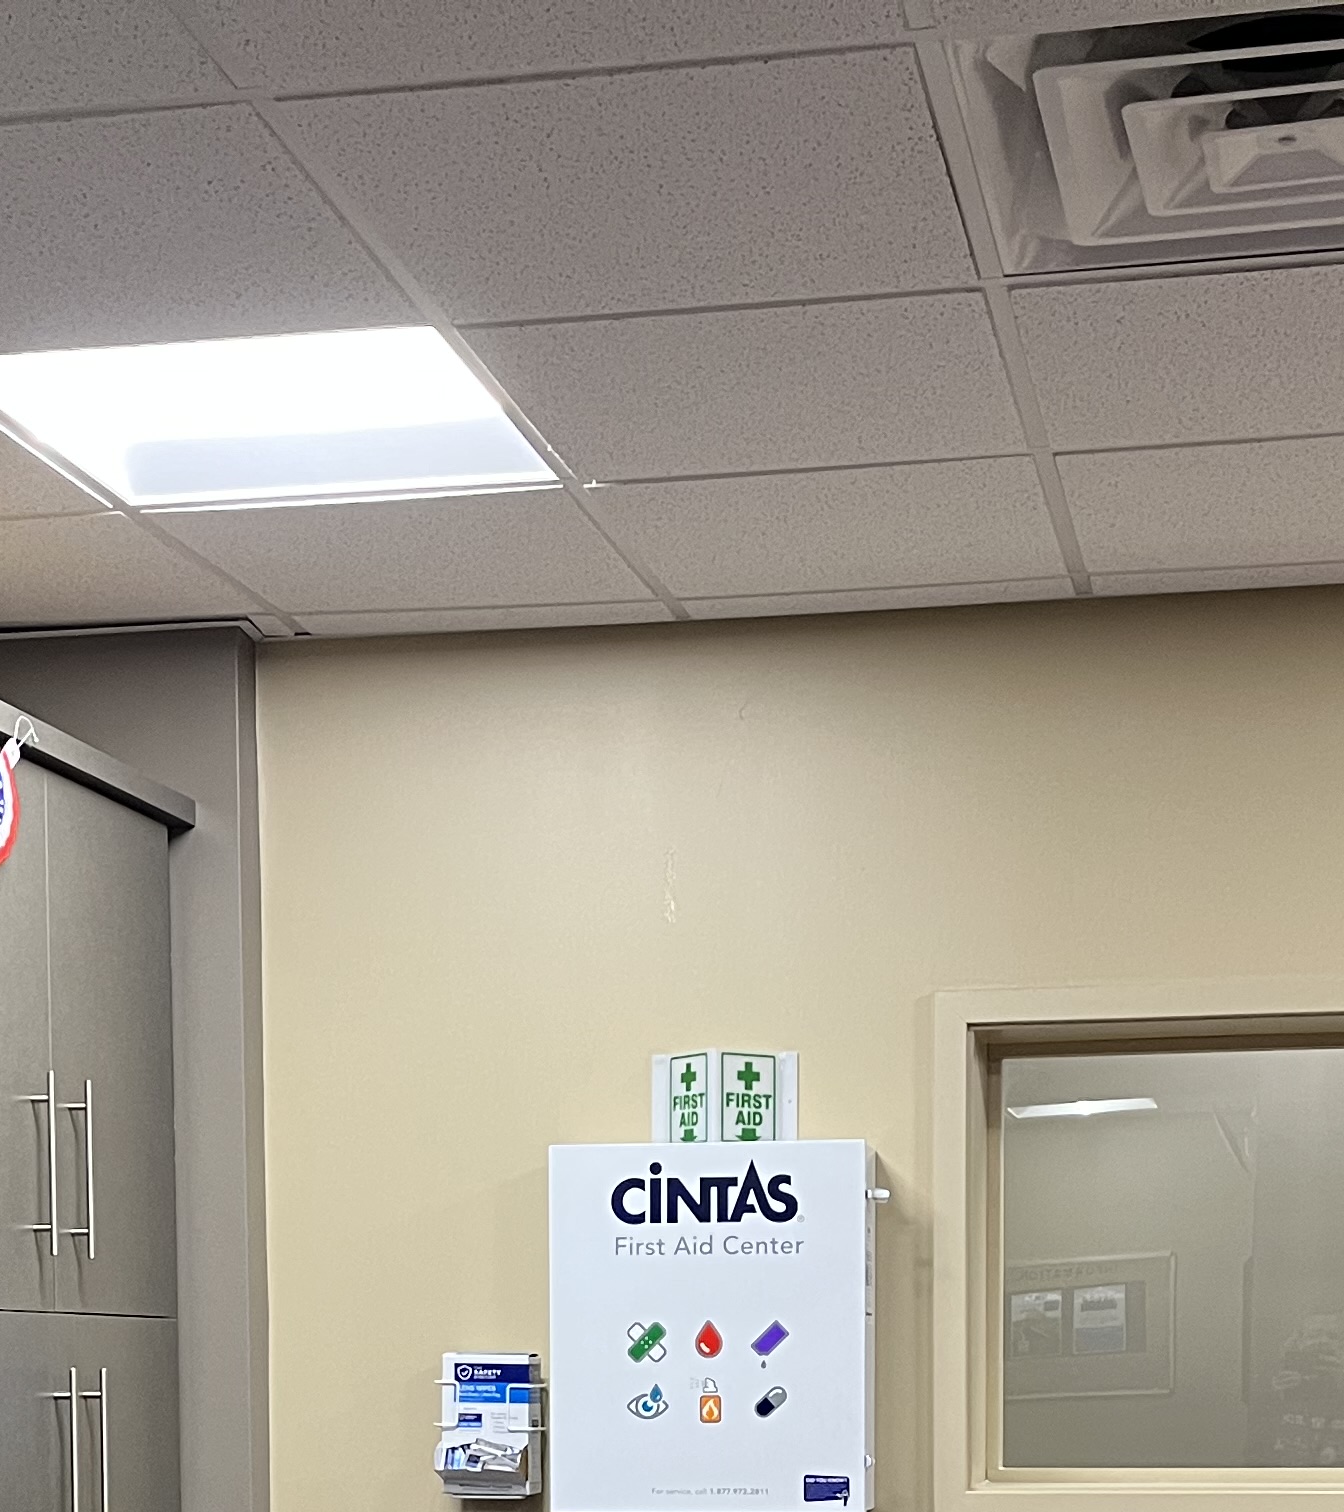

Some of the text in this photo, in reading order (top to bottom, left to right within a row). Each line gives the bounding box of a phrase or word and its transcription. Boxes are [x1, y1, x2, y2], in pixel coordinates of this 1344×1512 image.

[673, 1093, 705, 1111] FIRST
[726, 1092, 772, 1110] FIRST
[679, 1111, 698, 1127] AID
[735, 1110, 763, 1126] AID
[615, 1235, 805, 1255] First Aid Center
